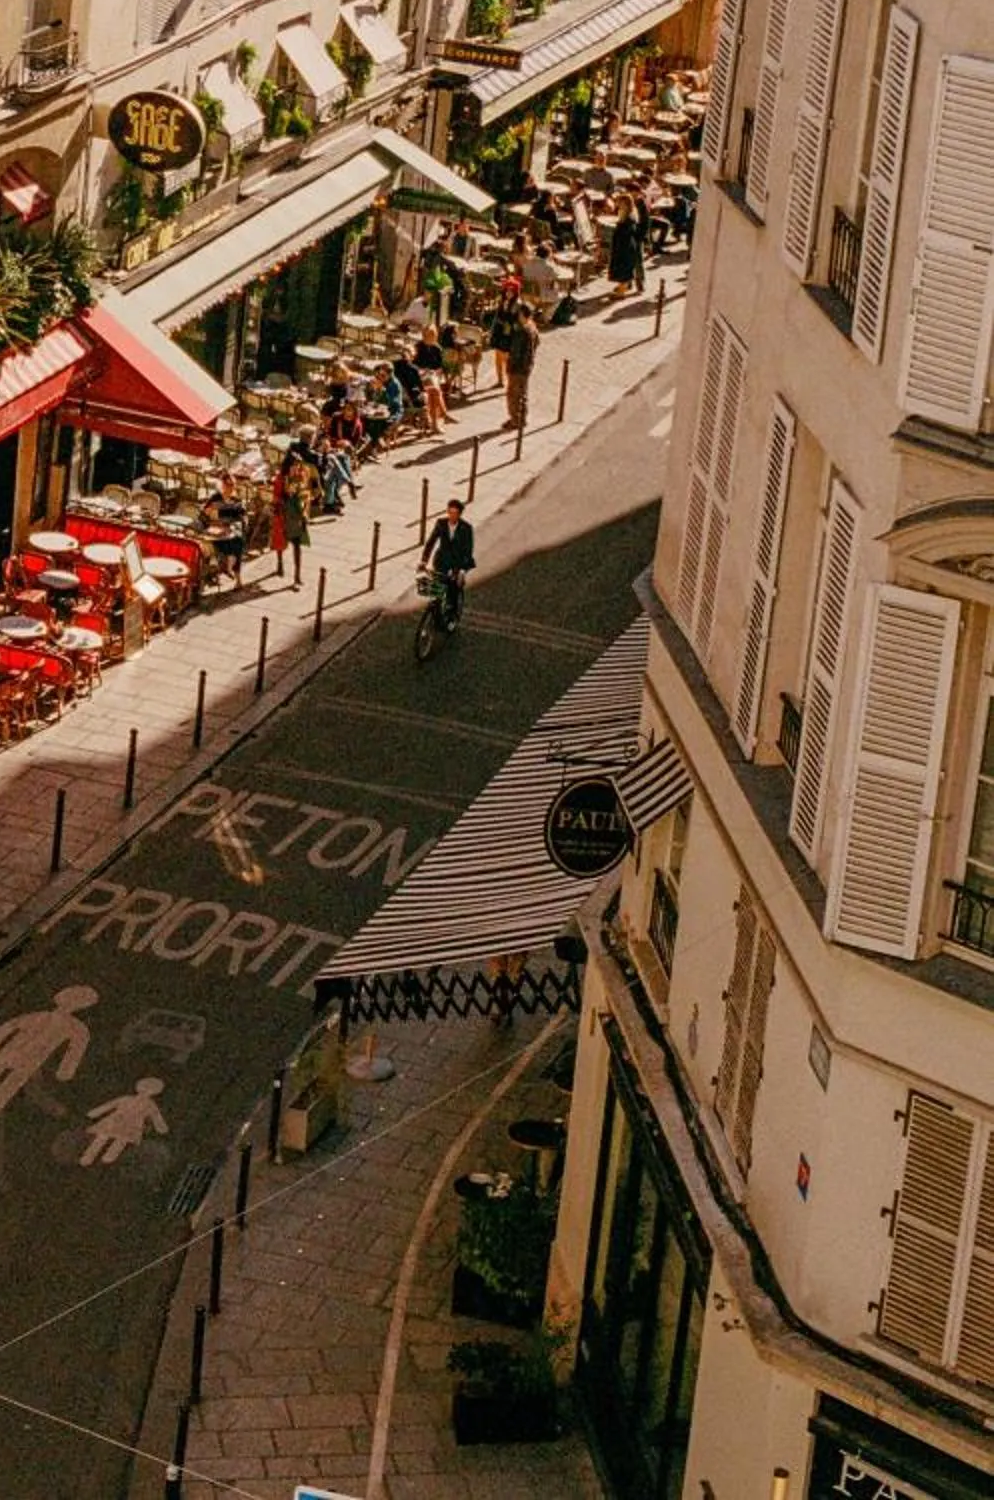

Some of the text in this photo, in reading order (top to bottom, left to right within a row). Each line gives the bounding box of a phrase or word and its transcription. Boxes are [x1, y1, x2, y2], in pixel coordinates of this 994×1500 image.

[148, 783, 438, 885] PIETON
[558, 809, 627, 832] PAUL
[37, 879, 347, 997] PRIORIT
